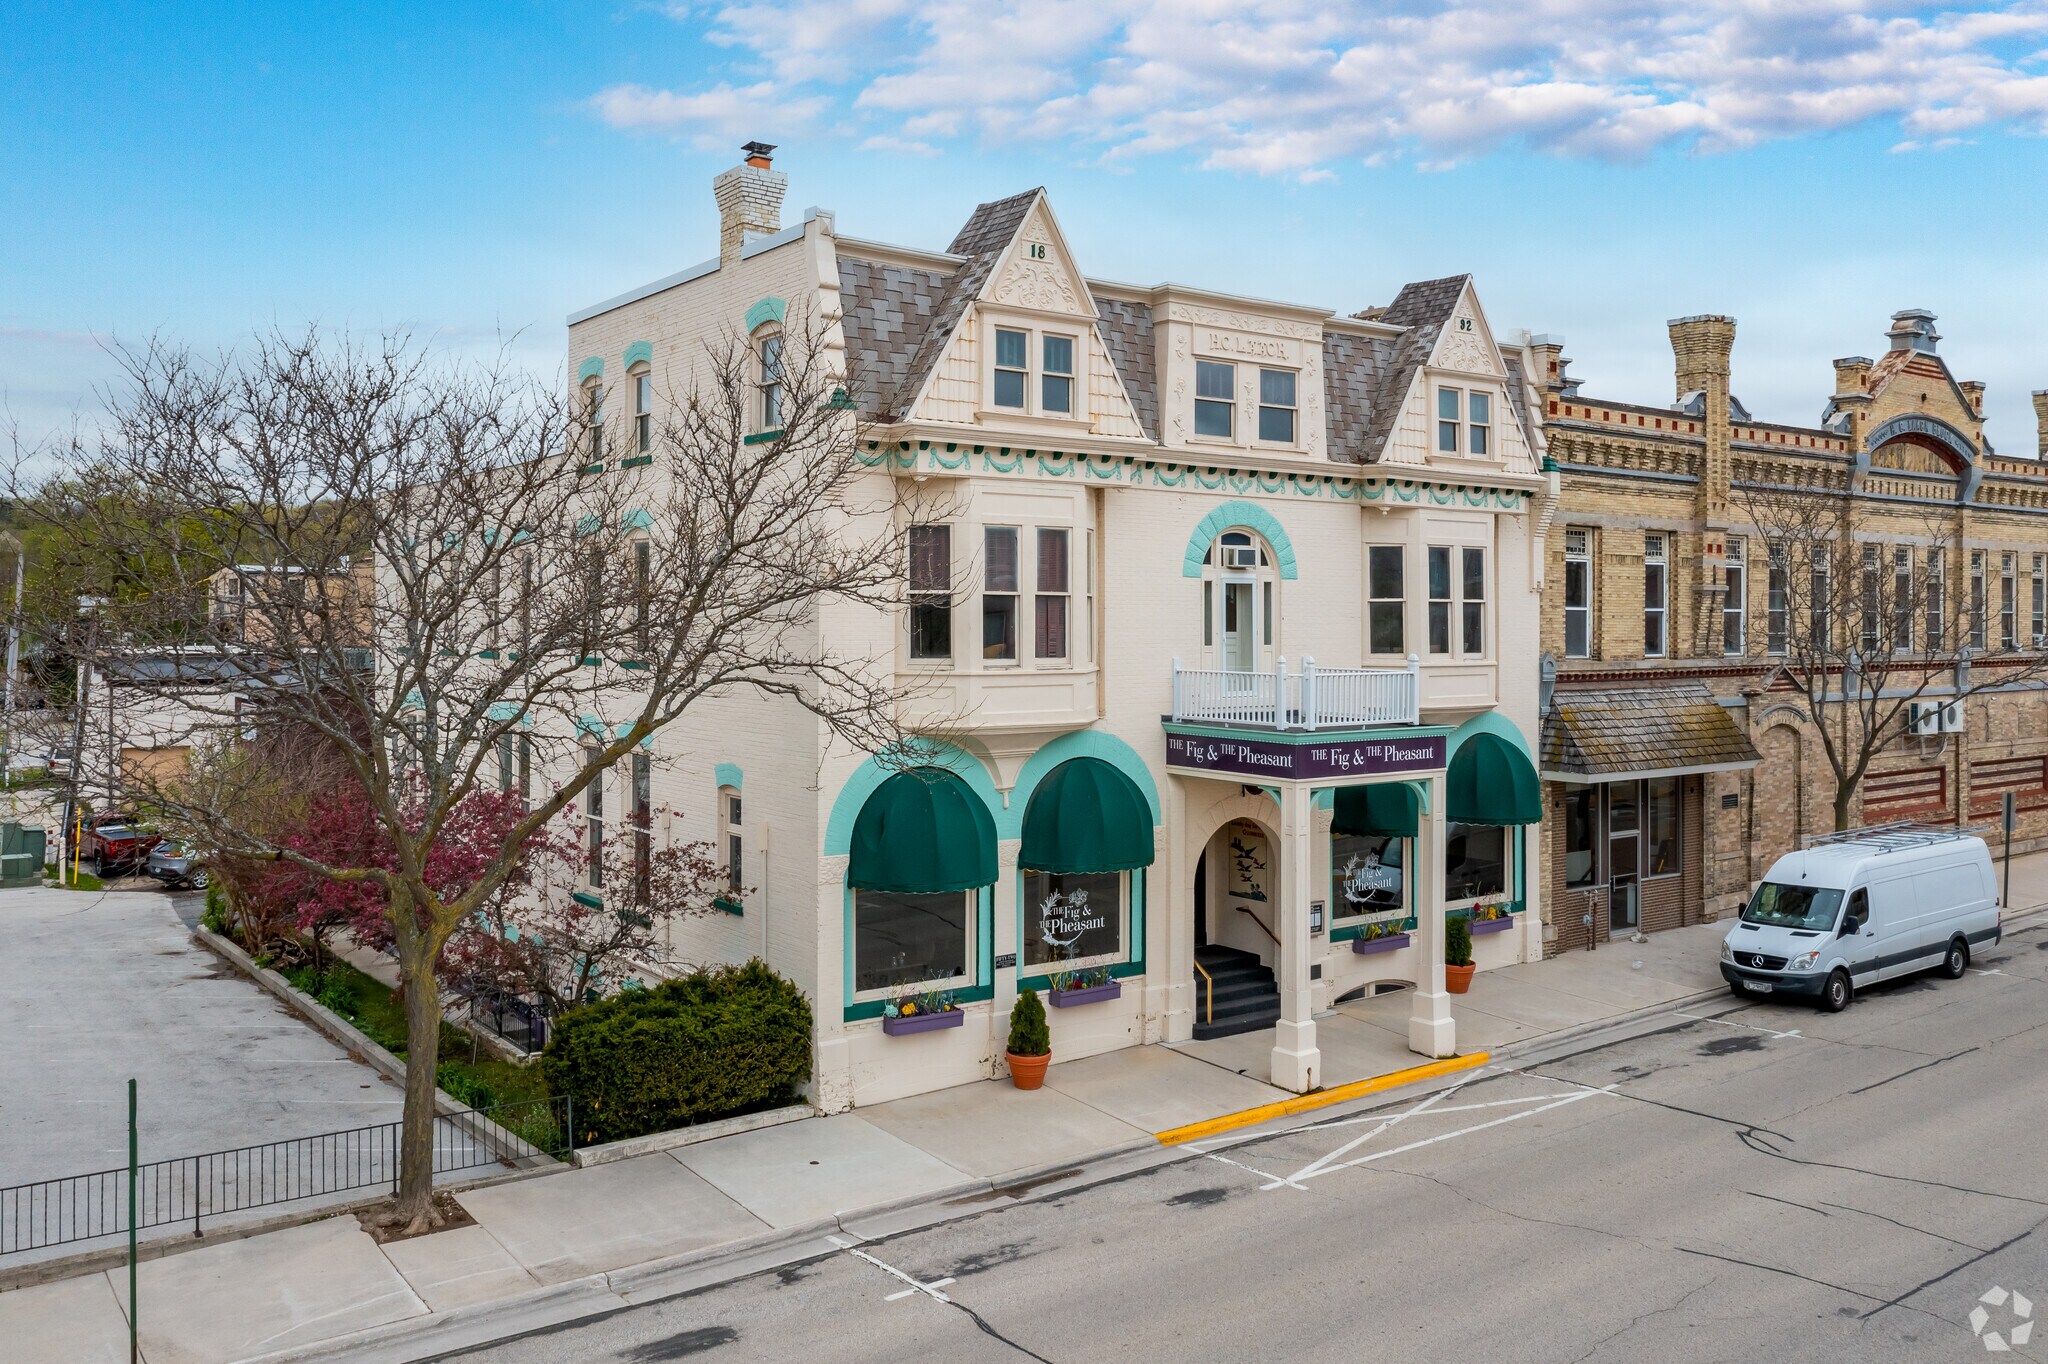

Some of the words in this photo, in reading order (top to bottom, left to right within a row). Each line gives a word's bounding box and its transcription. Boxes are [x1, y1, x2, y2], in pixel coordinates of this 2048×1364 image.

[1031, 243, 1046, 259] 18
[1460, 318, 1472, 332] 92
[1169, 738, 1184, 750] THE
[1186, 740, 1204, 763] Fig
[1207, 744, 1218, 761] &
[1220, 743, 1236, 755] THE
[1238, 745, 1293, 767] Pheasant
[1311, 748, 1327, 760] THE
[1330, 748, 1350, 770] Fig
[1353, 749, 1364, 765] &
[1366, 745, 1382, 757] THE
[1384, 745, 1434, 762] Pheasant
[1351, 877, 1392, 892] Pheasant
[1052, 906, 1064, 915] THE
[1064, 905, 1080, 921] Fig
[1082, 904, 1092, 916] &
[1051, 915, 1105, 935] Pheasant
